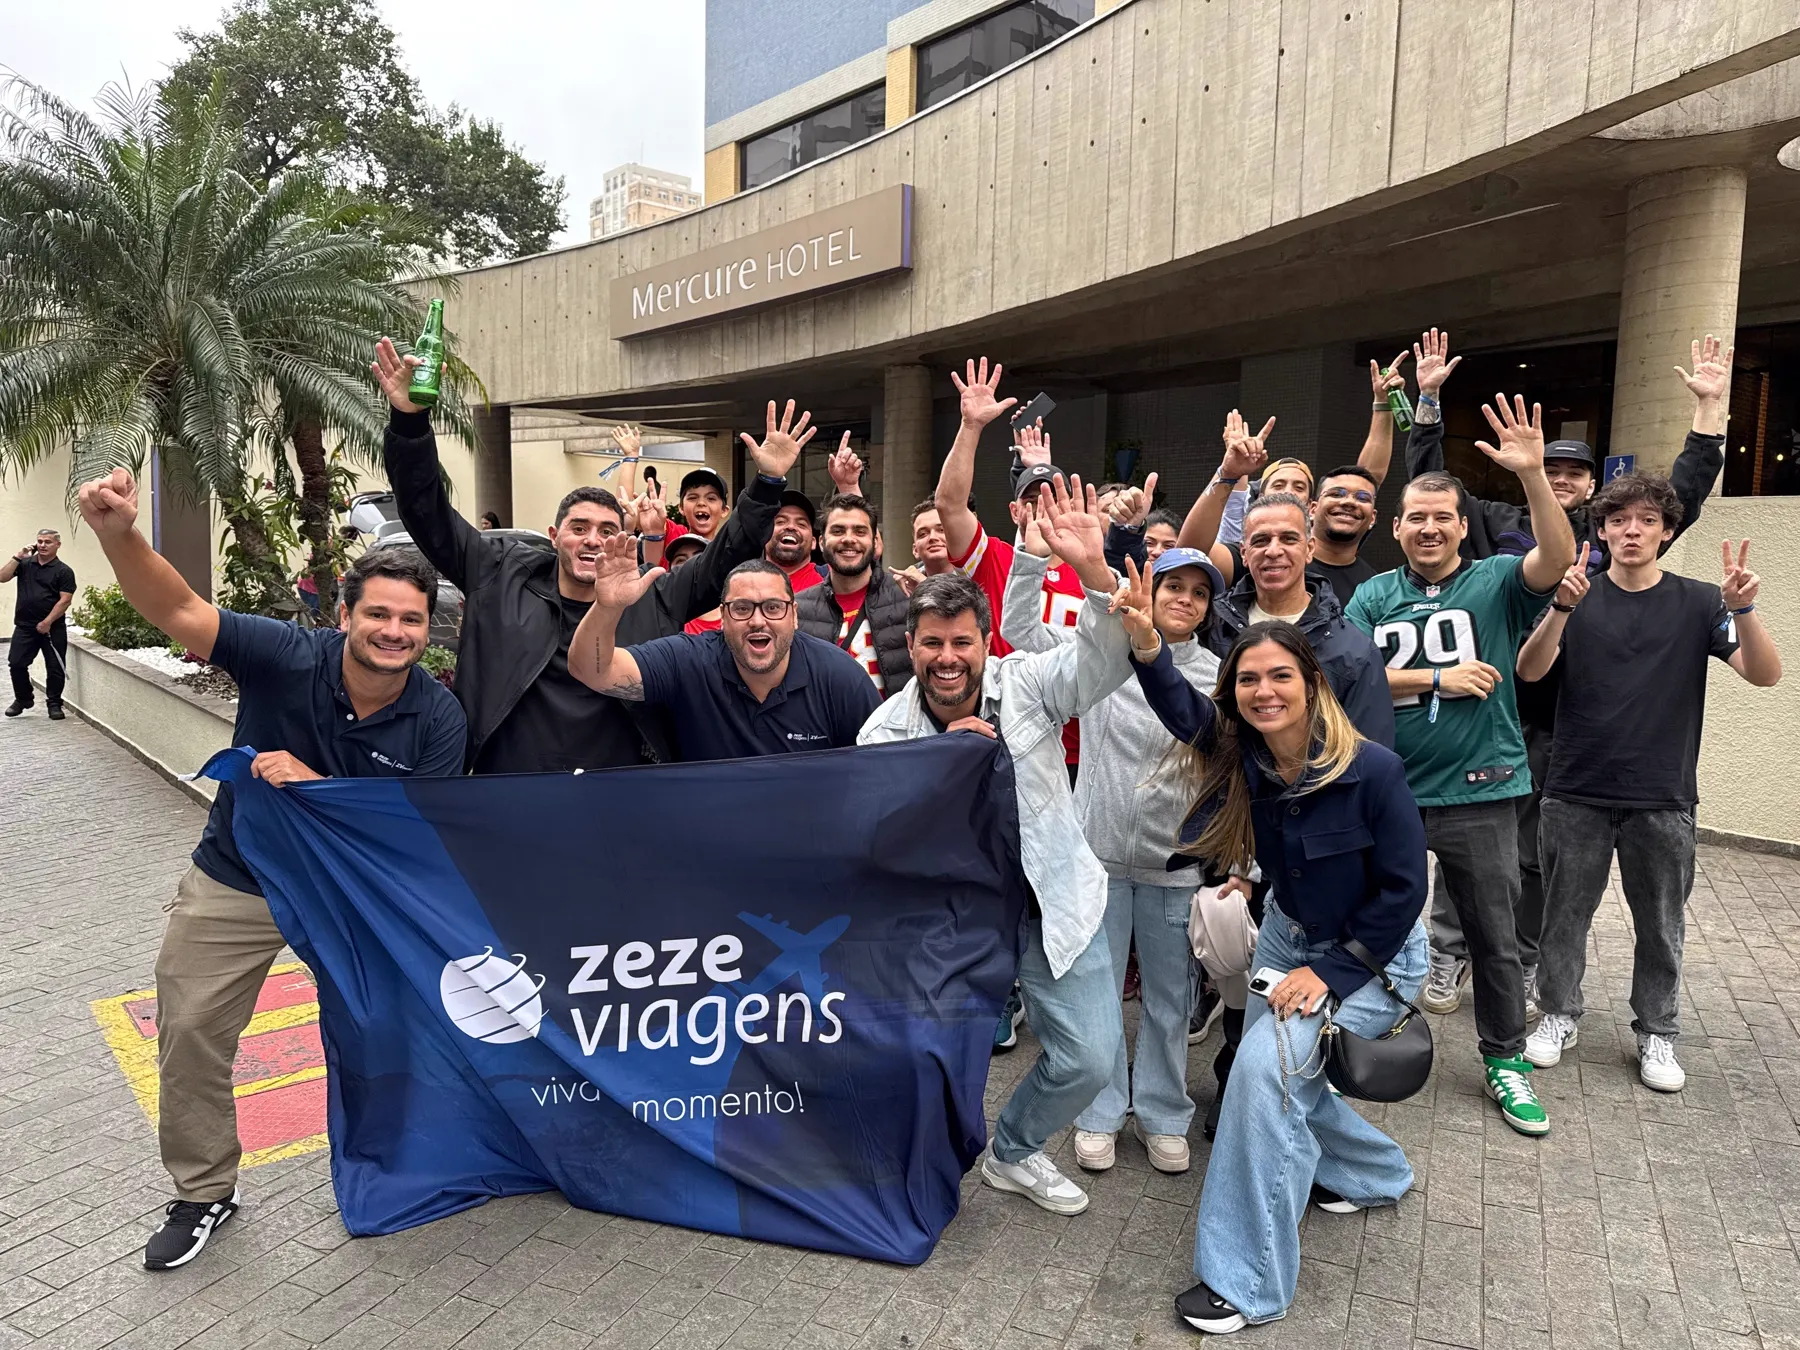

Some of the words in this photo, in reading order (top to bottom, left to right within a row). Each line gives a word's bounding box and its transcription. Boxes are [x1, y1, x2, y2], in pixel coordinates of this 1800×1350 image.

[631, 257, 757, 320] Mercure
[767, 226, 863, 285] HOTEL
[1373, 608, 1481, 707] 29
[567, 934, 744, 995] zeze
[570, 990, 846, 1067] viagens
[531, 1076, 601, 1107] viva
[632, 1081, 806, 1124] momento!
